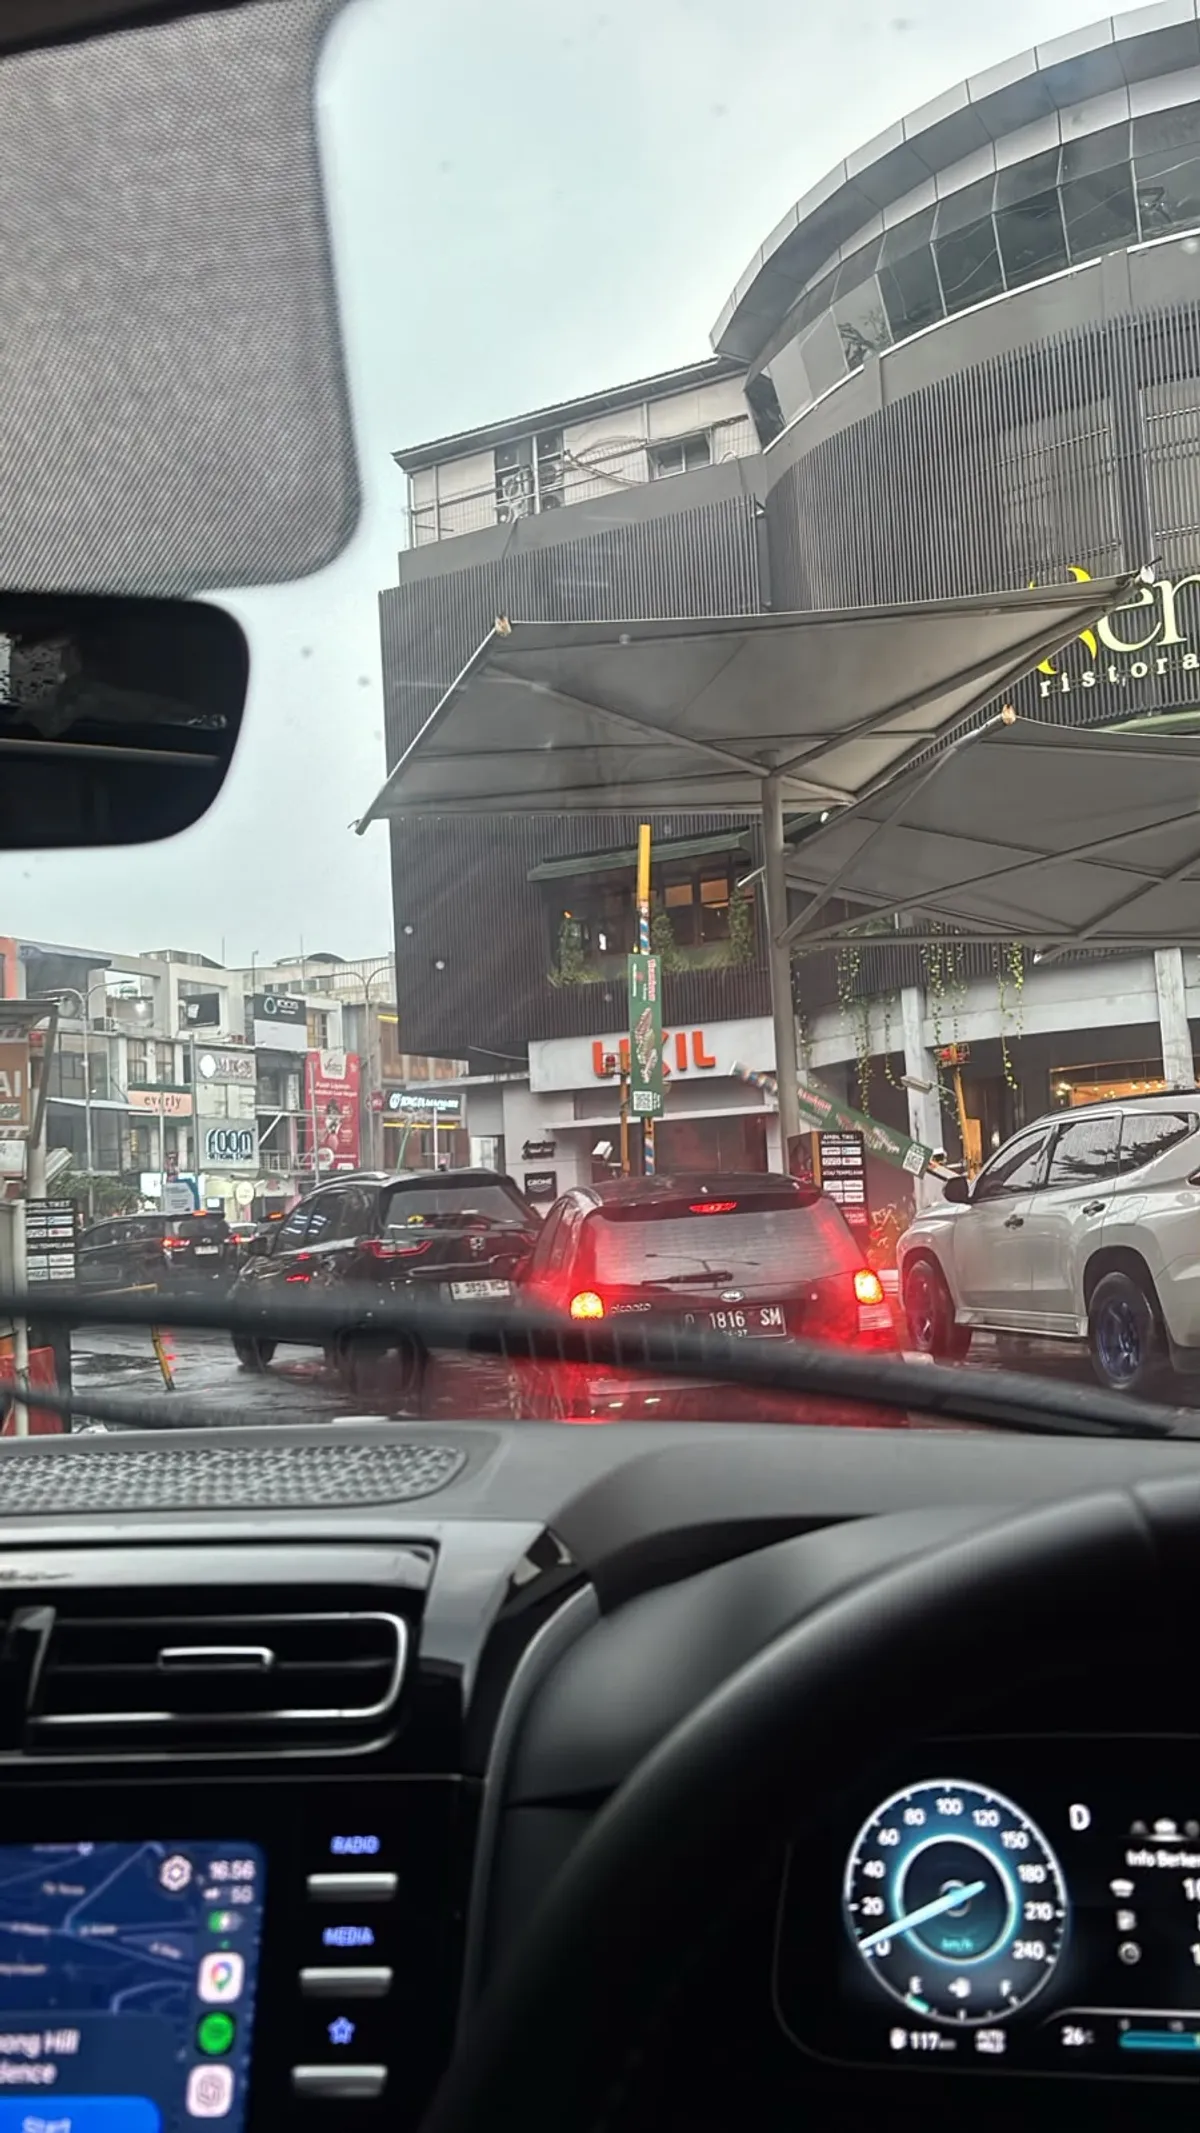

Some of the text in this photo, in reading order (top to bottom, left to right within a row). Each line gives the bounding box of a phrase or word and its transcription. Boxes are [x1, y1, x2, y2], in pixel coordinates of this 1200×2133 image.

[709, 1310, 746, 1330] 1816
[760, 1306, 782, 1327] SM
[936, 1798, 963, 1816] 100
[903, 1808, 925, 1826] 80
[972, 1810, 999, 1828] 120
[1069, 1803, 1091, 1831] D
[330, 1835, 380, 1854] RADIO
[877, 1828, 900, 1846] 60
[1001, 1830, 1029, 1850] 150
[1126, 1849, 1155, 1867] Info
[863, 1860, 885, 1878] 40
[1017, 1864, 1045, 1883] 180
[861, 1897, 884, 1916] 20
[1024, 1902, 1053, 1921] 210
[322, 1926, 374, 1946] MEDIA
[1012, 1940, 1045, 1960] 240
[910, 1976, 922, 1994] E
[44, 2029, 80, 2054] Hill
